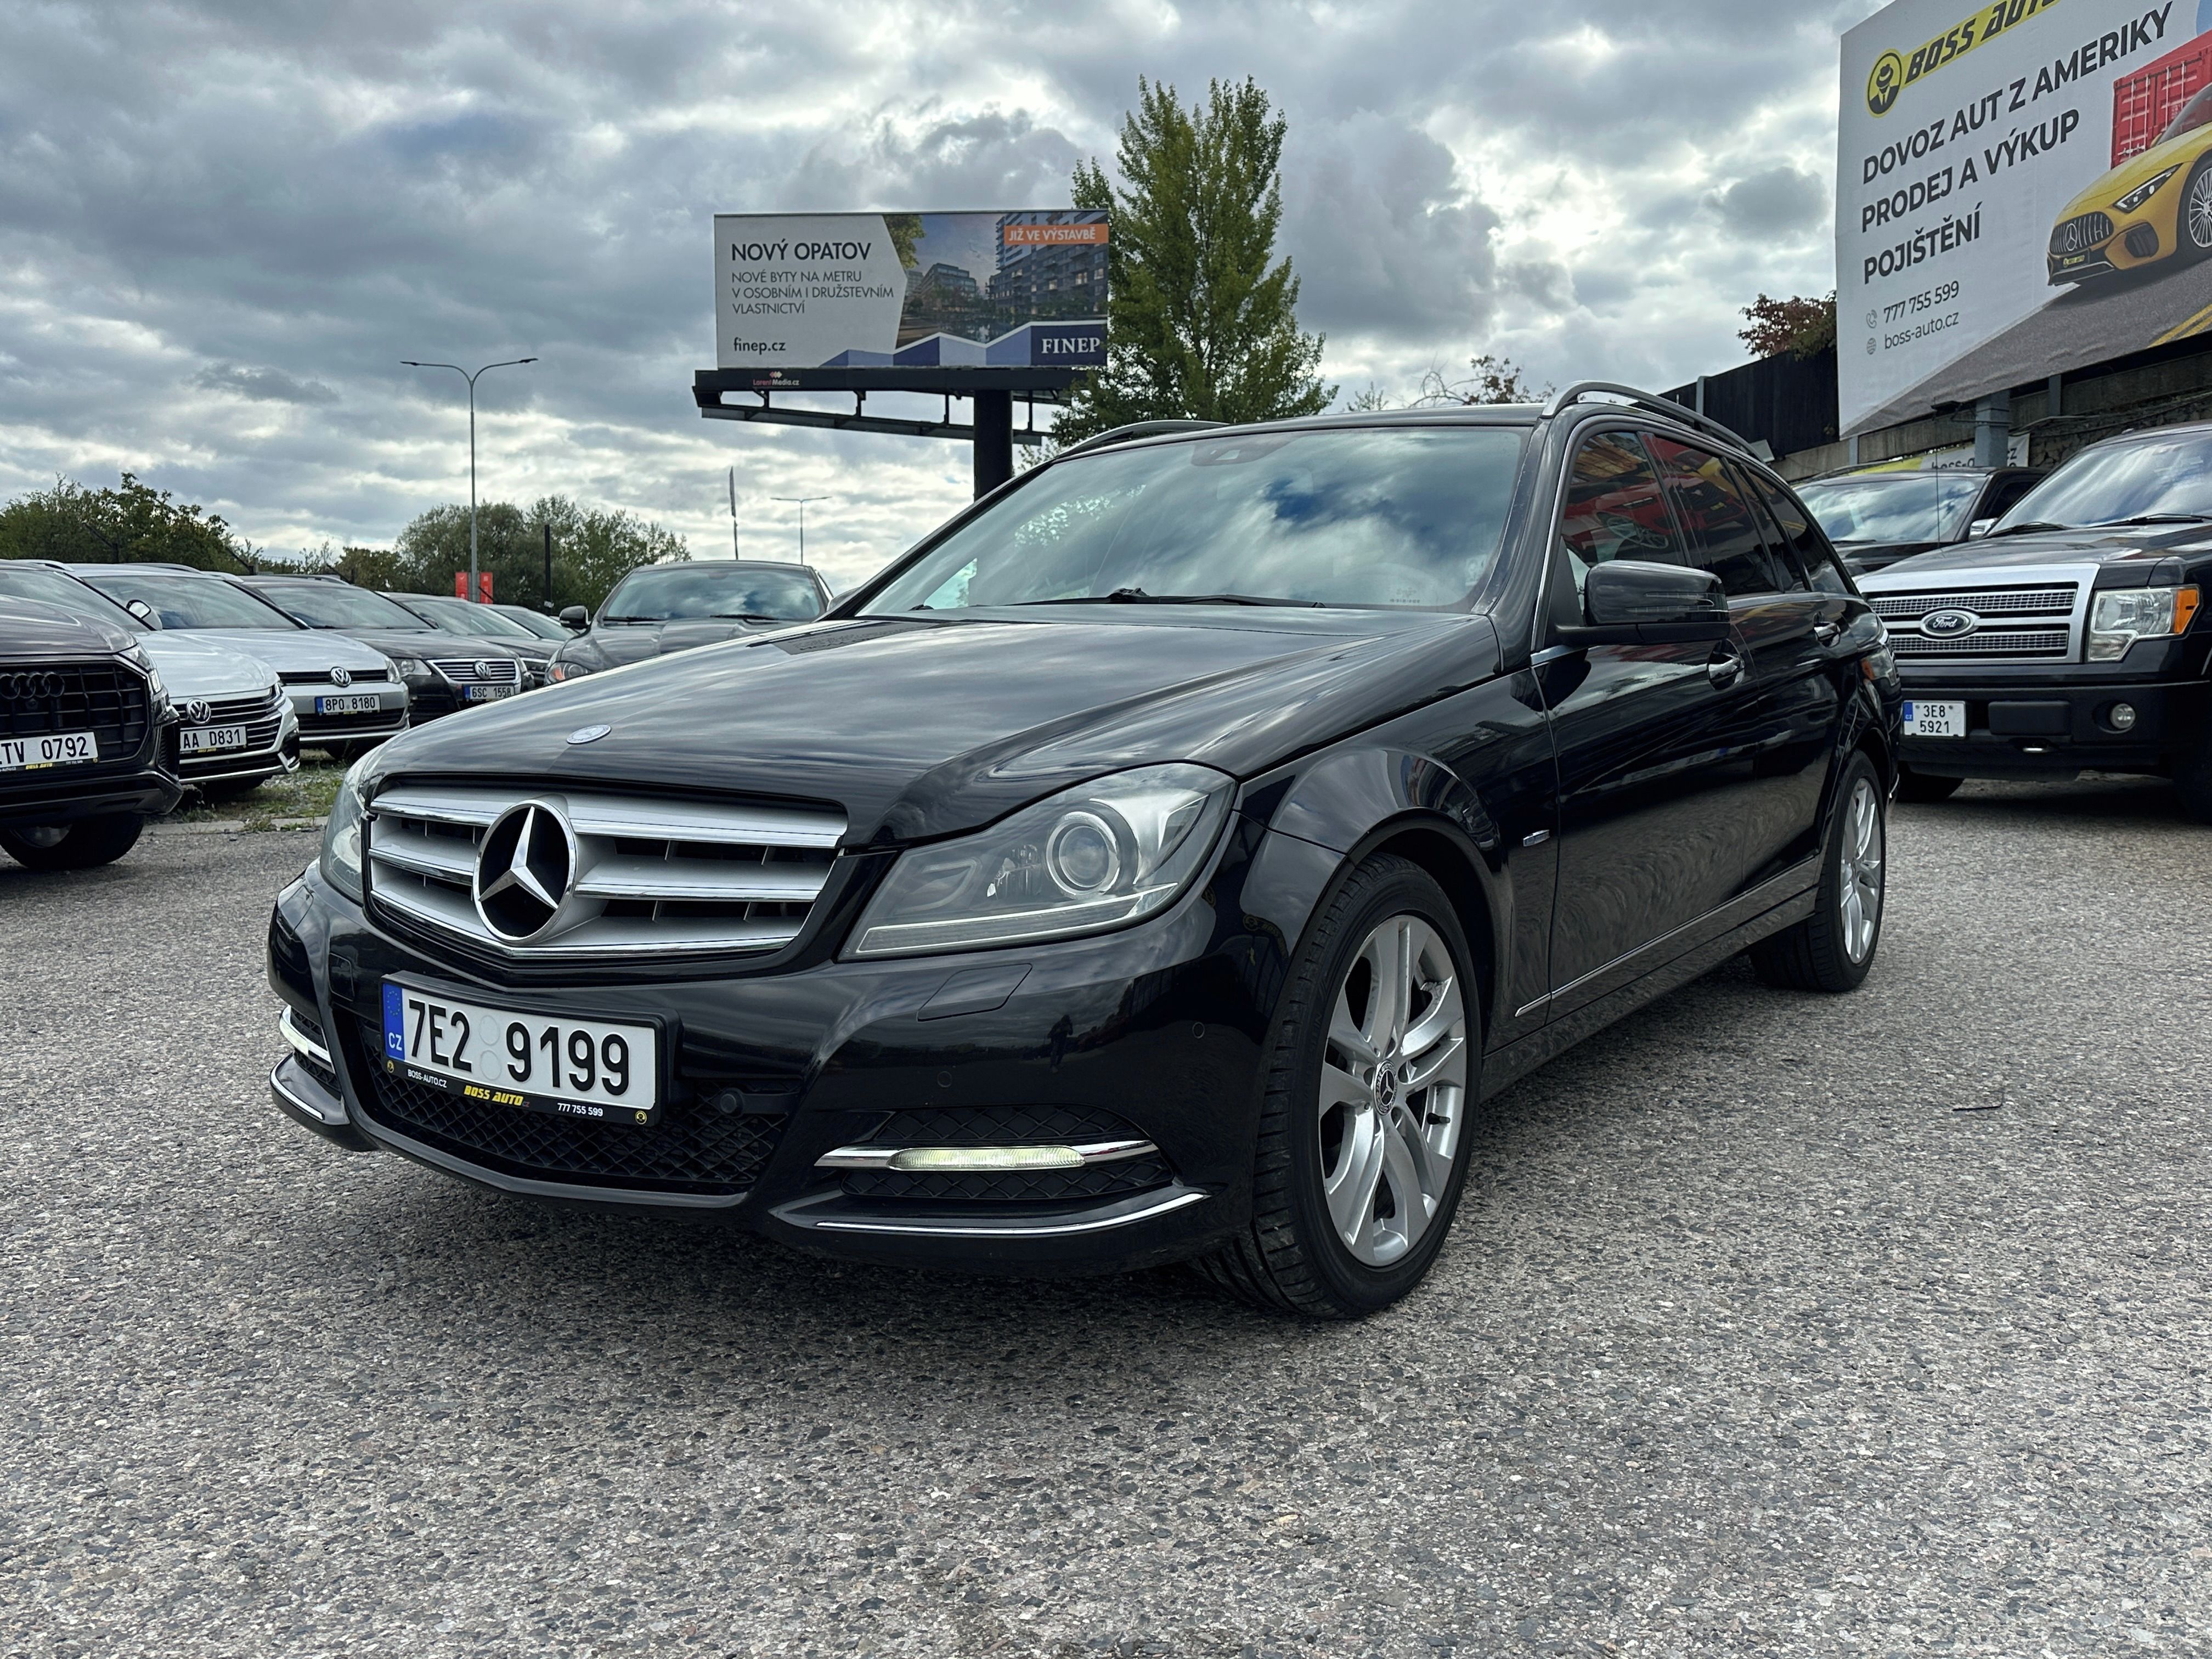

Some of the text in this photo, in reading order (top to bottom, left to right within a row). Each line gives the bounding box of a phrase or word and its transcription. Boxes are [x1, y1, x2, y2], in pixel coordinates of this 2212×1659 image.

[1905, 0, 2058, 84] BOSS AU
[1863, 1, 2173, 184] DOVOZ AUT Z AMERIKY
[1862, 109, 2079, 233] PRODEJ A VÝKUP
[1009, 227, 1096, 241] JIŽ VE VÝSTAVBĚ
[1864, 201, 1983, 285] POJIŠTĚNÍ
[732, 238, 871, 261] NOVÝ OPATOV
[732, 269, 861, 283] NOVÉ BYTY NA METRU
[732, 287, 741, 298] V
[743, 284, 802, 298] OSOBNÍM
[812, 284, 894, 298] DRUŽSTEVNÍM
[732, 300, 805, 314] VLASTNICTVÍ
[1883, 280, 1959, 323] 777 755 599
[1884, 312, 1960, 349] boss-auto.cz
[733, 337, 786, 355] finep.cz
[1041, 337, 1101, 353] FINEP
[1933, 616, 1957, 628] Ford
[472, 687, 487, 698] 6SC
[352, 697, 375, 709] 8180
[1923, 705, 1946, 718] 3E8
[1920, 720, 1949, 733] 5921
[183, 729, 240, 749] AA D831
[0, 736, 88, 764] TV 0792
[388, 1032, 403, 1051] CZ
[409, 998, 629, 1096] 7E2 9199
[408, 1069, 448, 1088] BOSS-AUTO.CZ
[464, 1085, 490, 1099] BOSS
[492, 1092, 524, 1106] AUTO
[557, 1102, 603, 1117] 777 755 599
